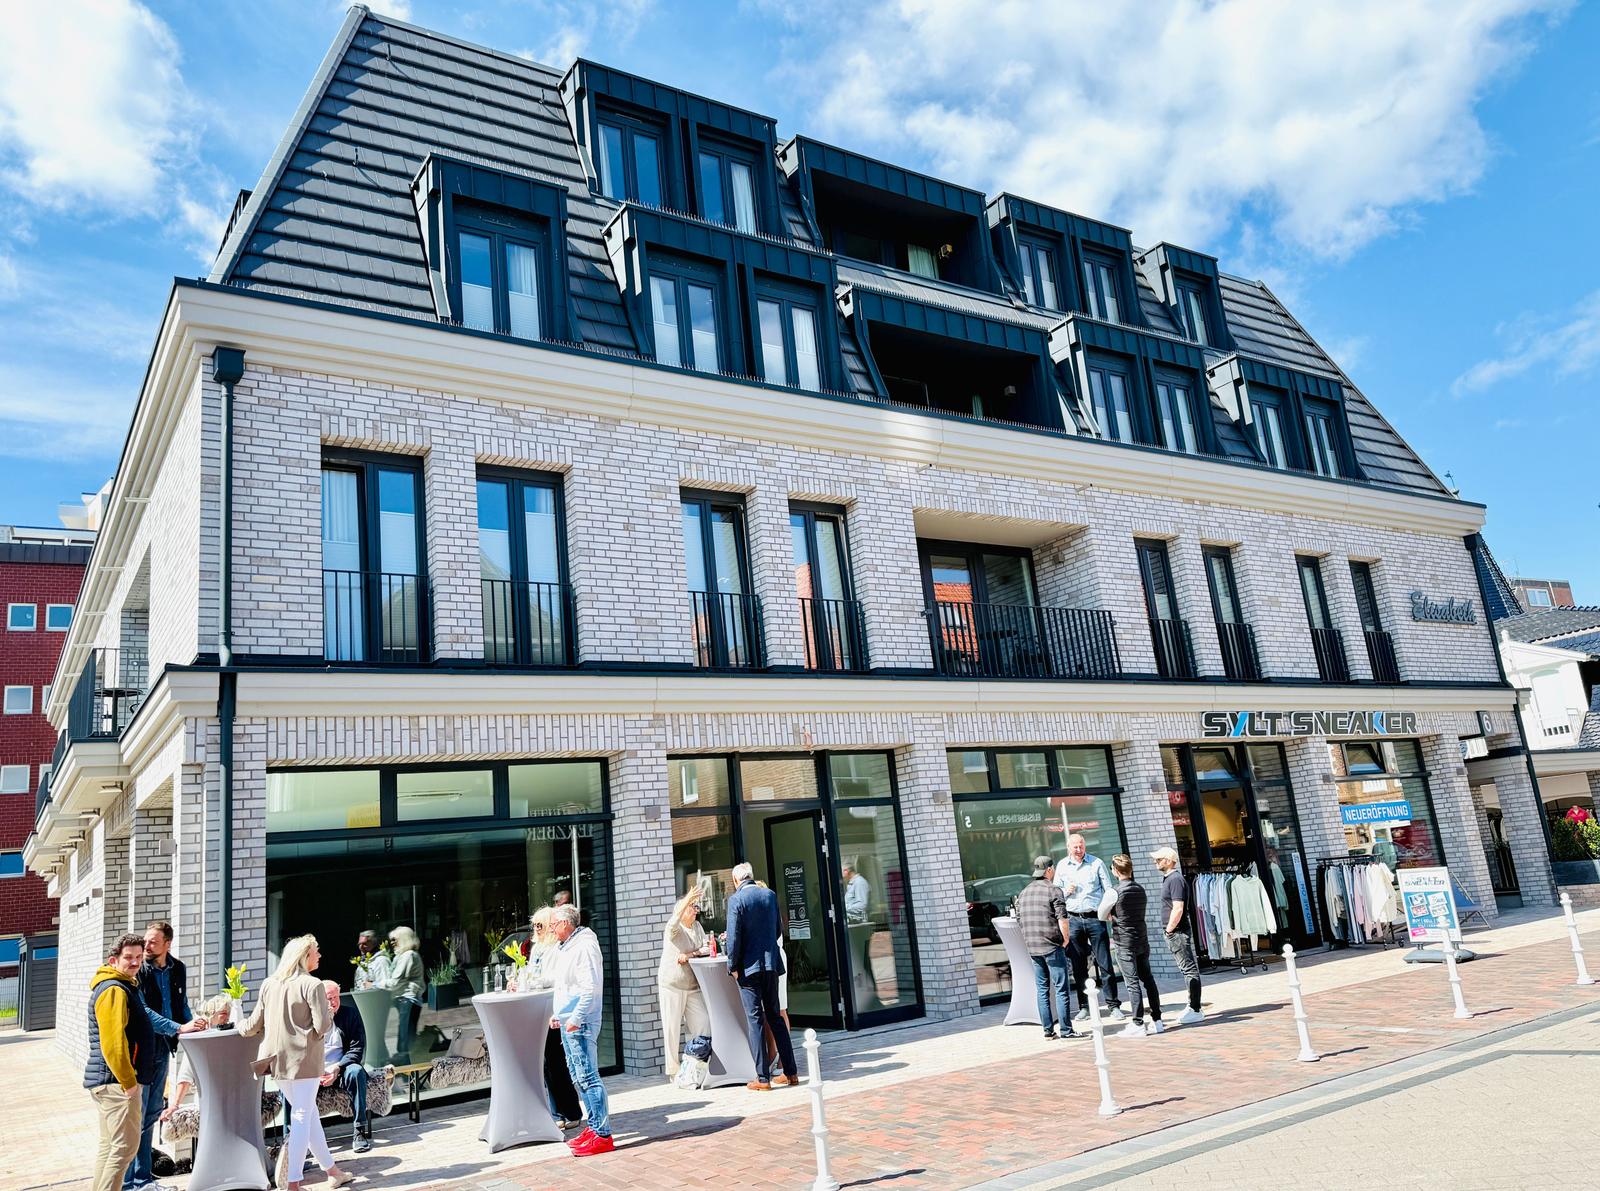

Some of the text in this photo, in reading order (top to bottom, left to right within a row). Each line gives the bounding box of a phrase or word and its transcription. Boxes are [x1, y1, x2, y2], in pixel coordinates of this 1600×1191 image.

[1203, 711, 1418, 737] SYLT SNEAKER
[1482, 714, 1492, 732] 6
[1345, 804, 1408, 821] NEUERÖFFNUNG
